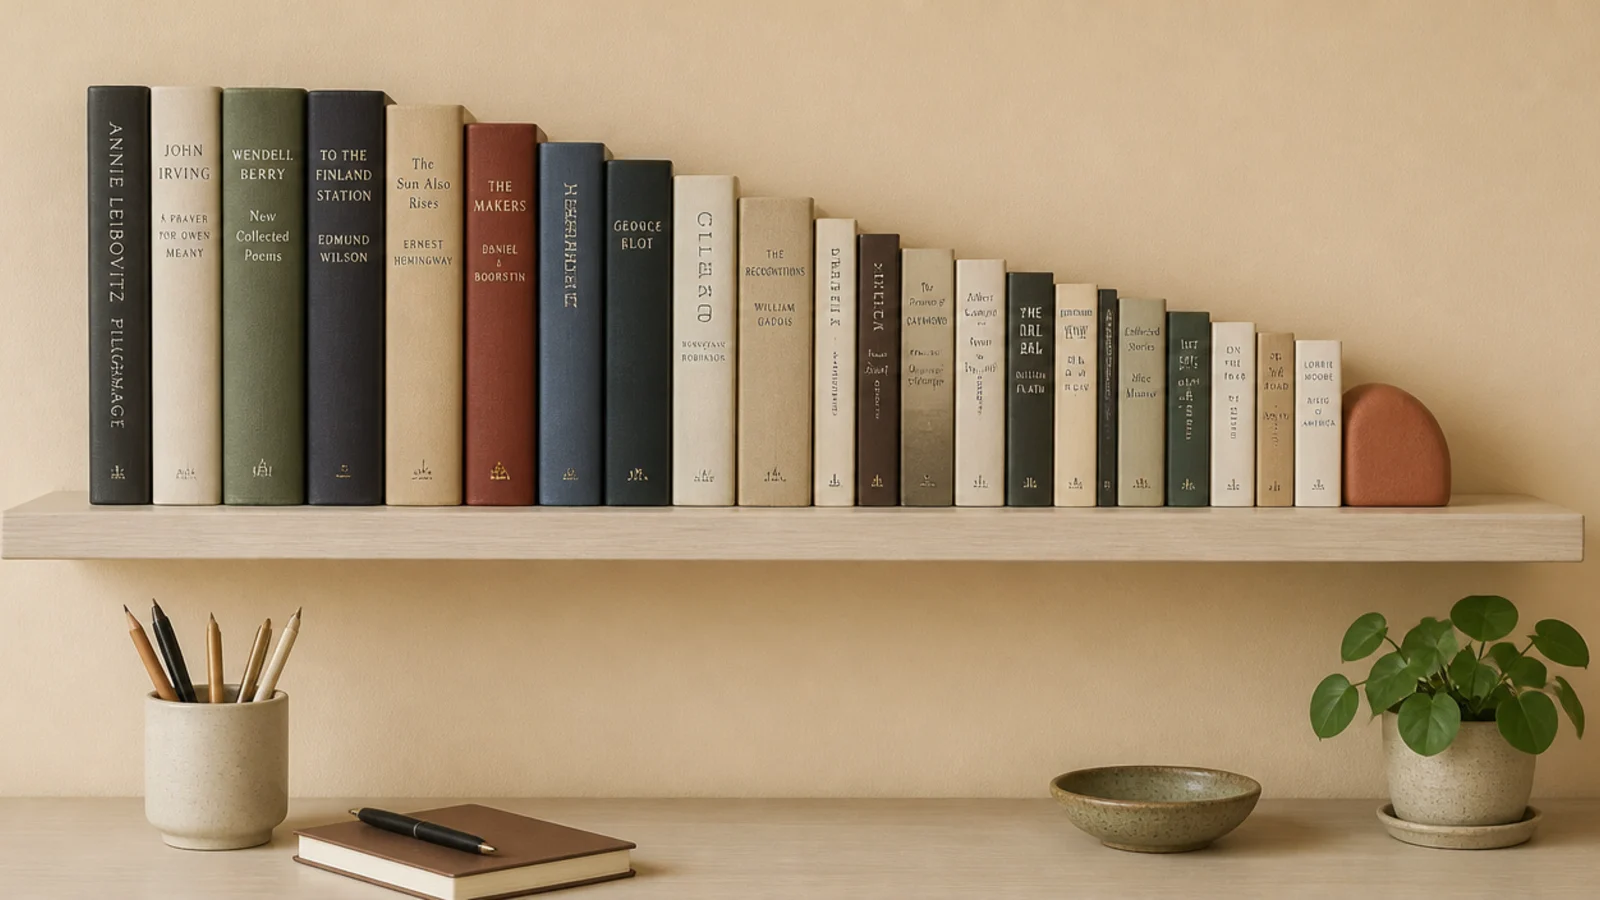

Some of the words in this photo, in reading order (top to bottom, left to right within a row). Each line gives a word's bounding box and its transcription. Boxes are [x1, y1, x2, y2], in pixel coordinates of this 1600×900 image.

[110, 122, 123, 187] ANNIE
[165, 145, 202, 156] JOHN
[320, 150, 336, 161] TO
[342, 150, 366, 161] THE
[412, 157, 433, 170] The
[160, 168, 209, 179] IRVING
[240, 169, 285, 179] BERRY
[316, 169, 372, 180] FINLAND
[397, 178, 419, 189] Sun
[424, 178, 451, 189] Also
[488, 181, 511, 192] THE
[317, 190, 371, 201] STATION
[410, 197, 438, 209] Rises
[474, 200, 525, 211] MAKERS
[250, 210, 276, 221] New
[179, 231, 210, 241] OWEN
[236, 230, 289, 242] Collected
[319, 235, 369, 245] EDMUND
[110, 198, 124, 302] LEIBOVITZ
[403, 240, 444, 250] ERNEST
[165, 249, 204, 258] MEANY
[245, 249, 281, 261] Poems
[320, 252, 367, 262] WILSON
[766, 250, 784, 259] THE
[393, 256, 453, 266] HEMINGWAY
